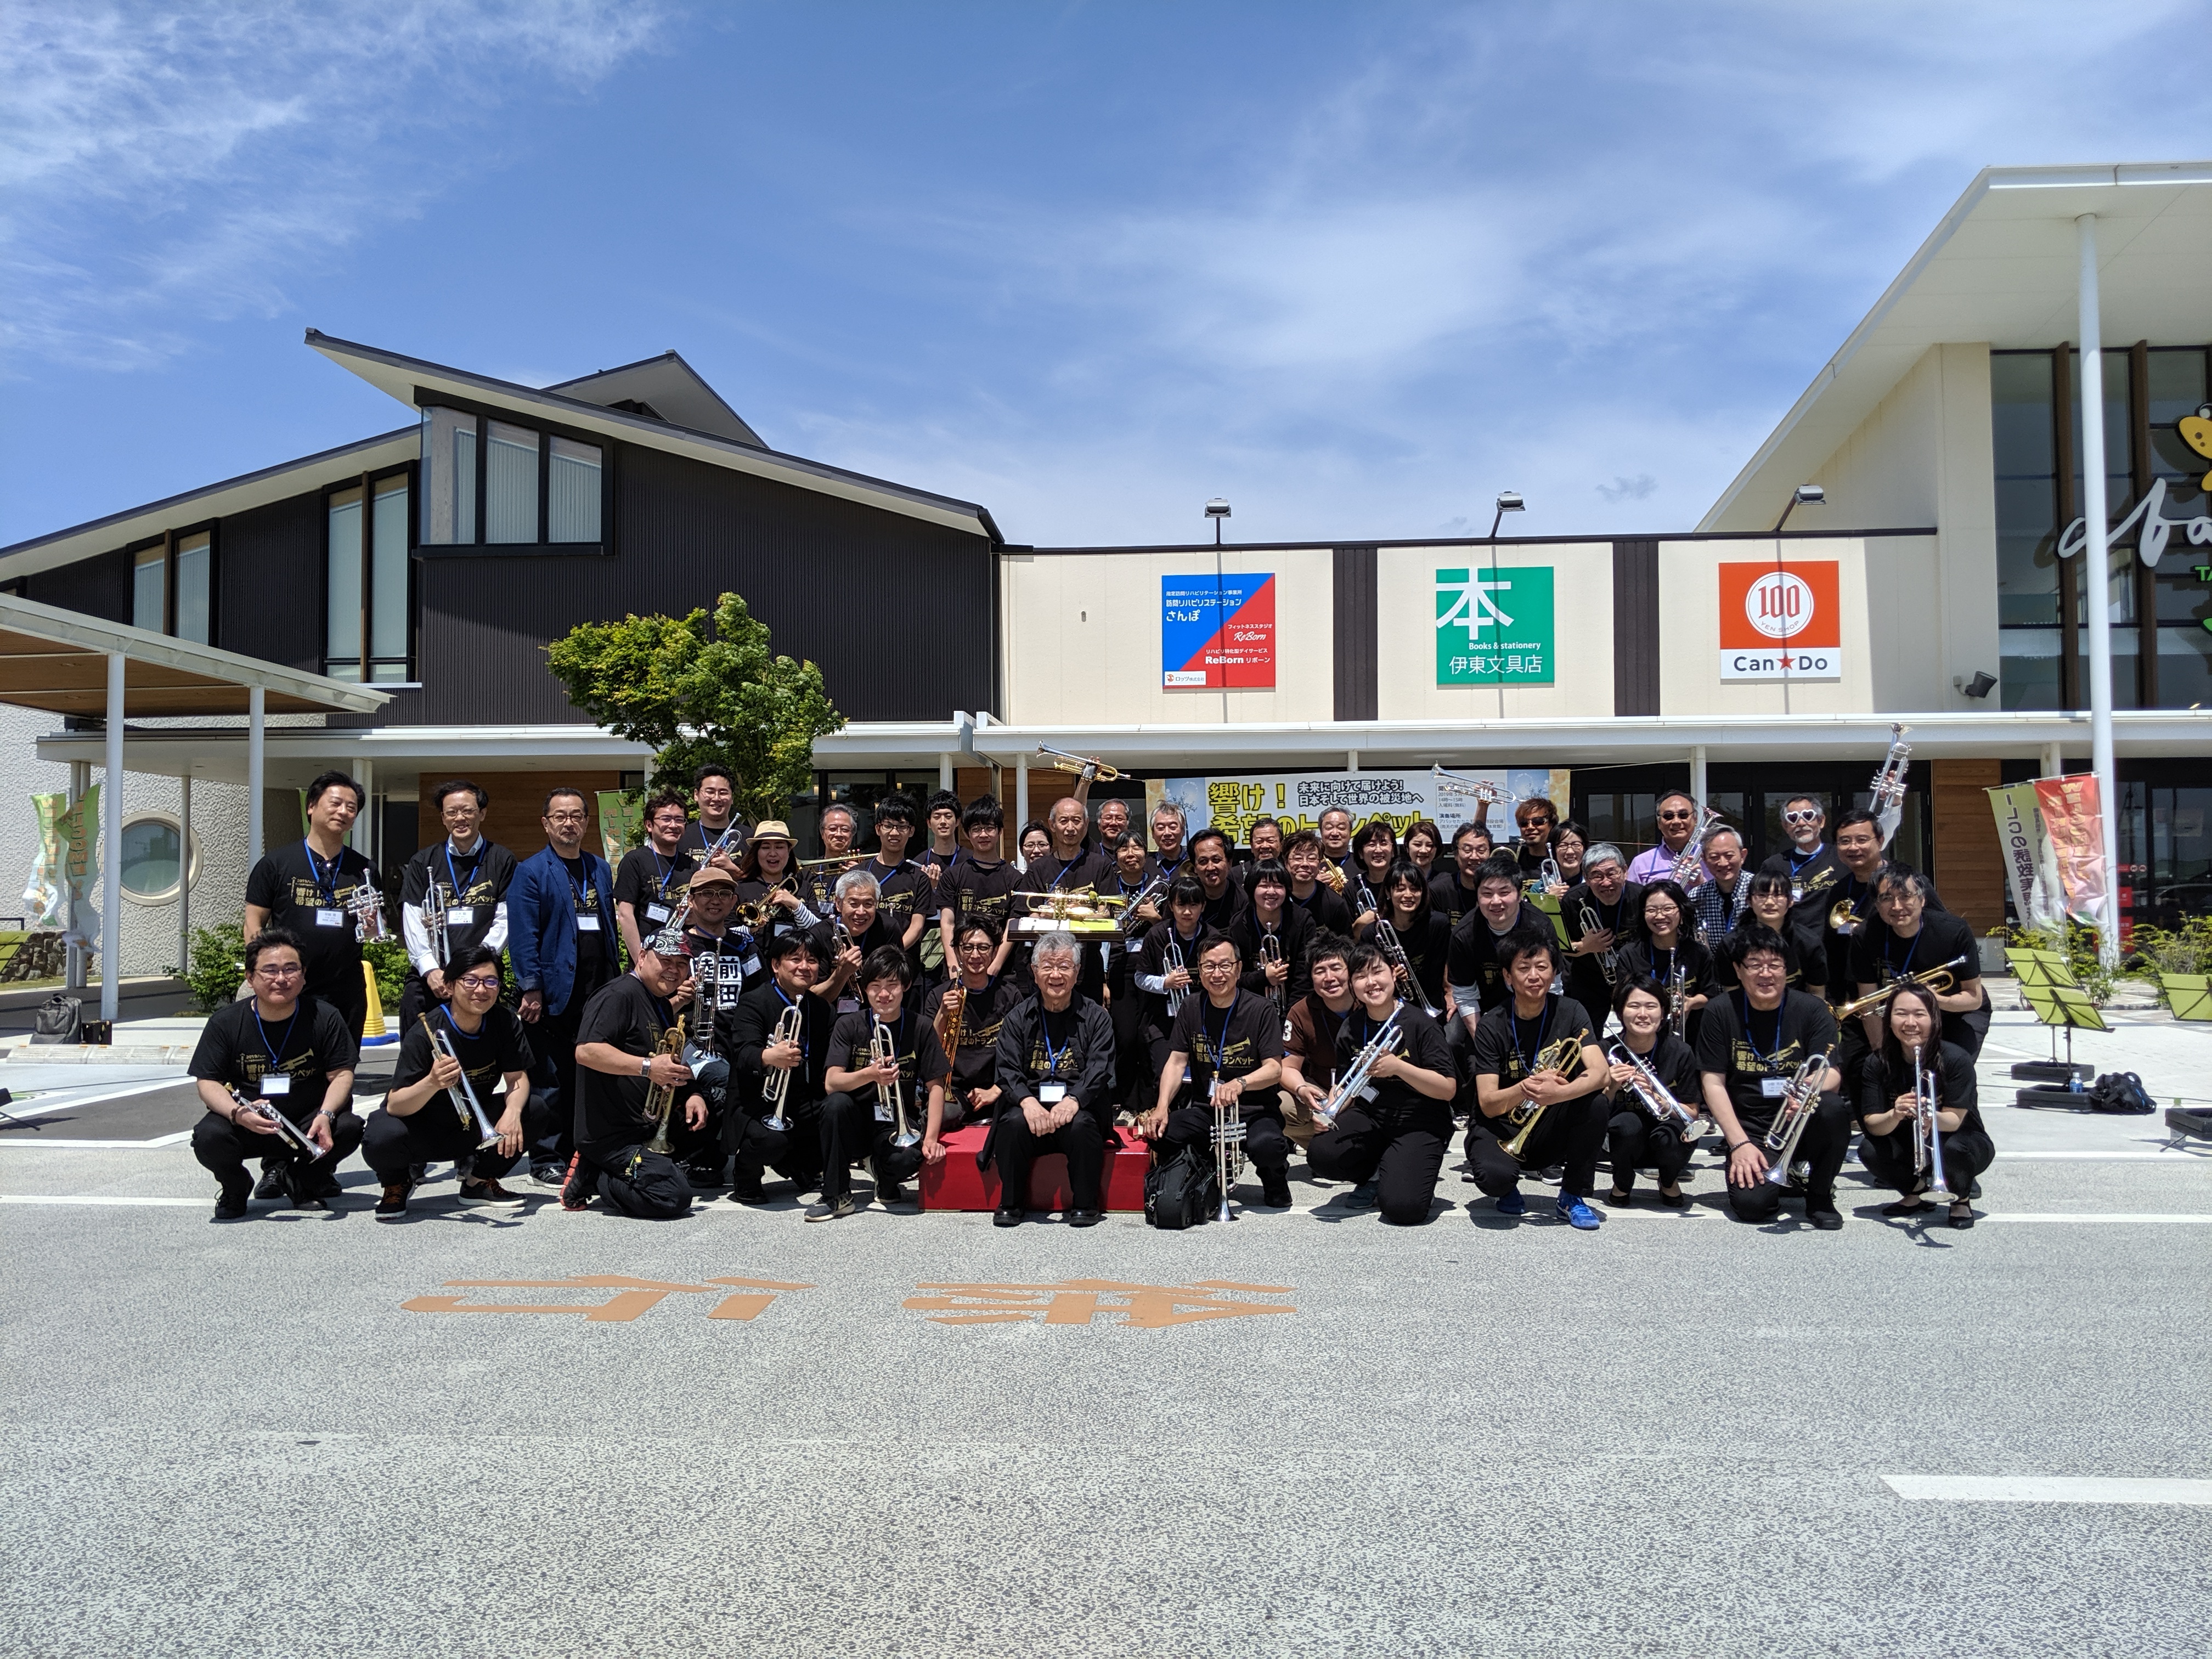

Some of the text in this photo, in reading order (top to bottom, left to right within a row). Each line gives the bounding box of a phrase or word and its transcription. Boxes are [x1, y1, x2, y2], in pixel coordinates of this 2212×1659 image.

[1166, 599, 1242, 607] 訪問リハビリステーション
[1436, 568, 1514, 640] 本
[1758, 584, 1800, 619] 100
[1166, 610, 1200, 622] さんぽ
[1760, 620, 1799, 633] YEN SHOP
[1234, 631, 1266, 642] ReBorn
[1500, 641, 1541, 651] stationery
[1449, 654, 1543, 675] 伊東文具店
[1734, 656, 1828, 672] Can Do
[1298, 791, 1424, 807] 日本そして世界の被災地へ
[1210, 810, 1433, 845] 希望のトンペット
